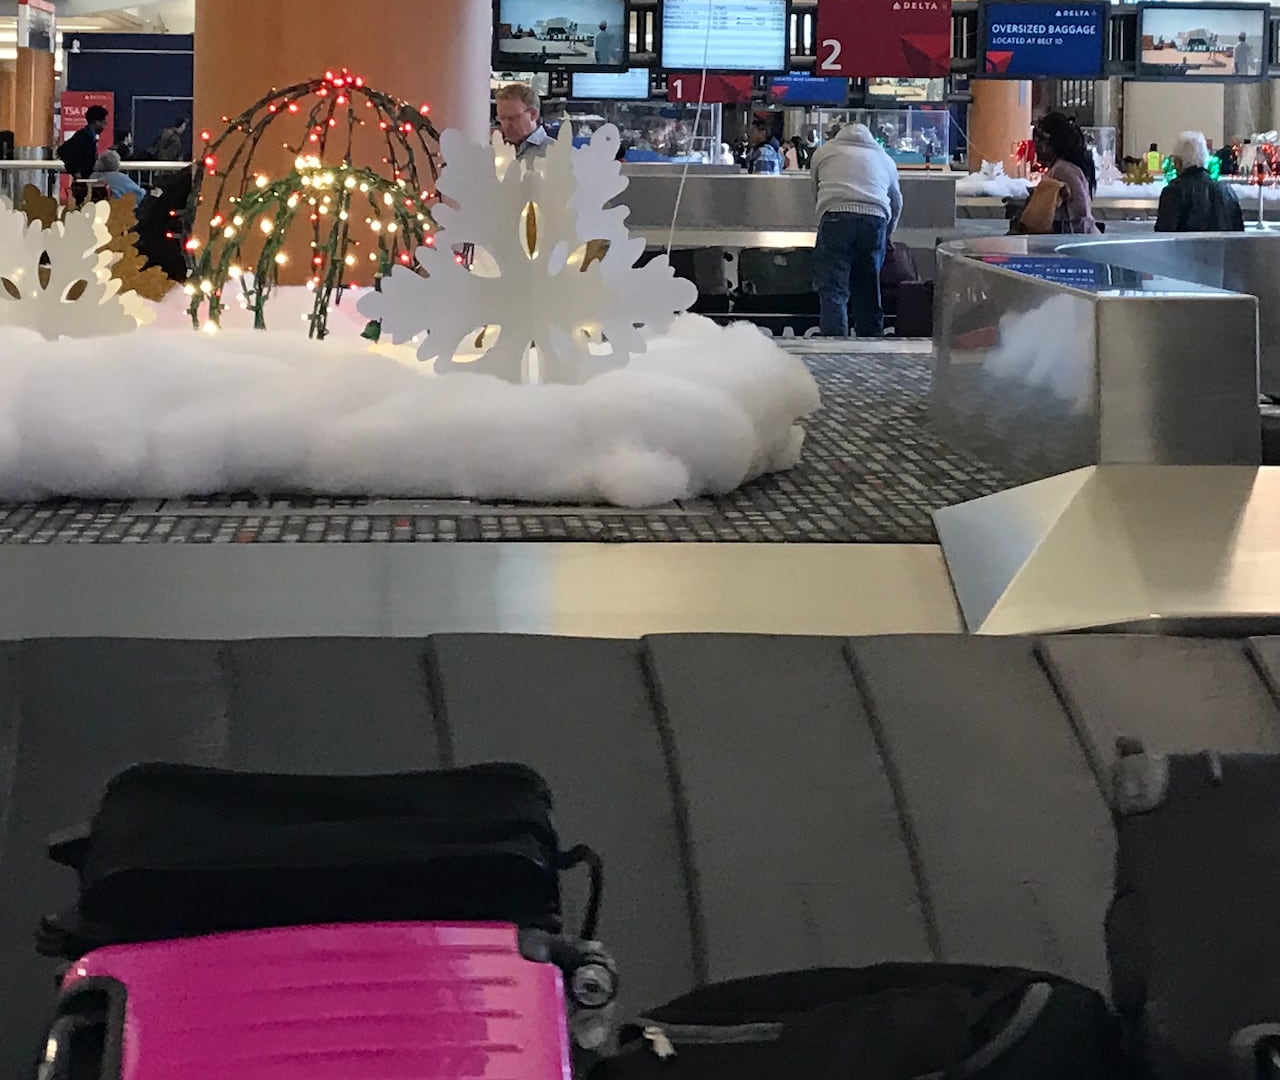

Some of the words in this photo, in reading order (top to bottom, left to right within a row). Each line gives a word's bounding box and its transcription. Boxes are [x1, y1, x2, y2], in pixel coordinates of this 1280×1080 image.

[904, 2, 938, 10] DELTA
[992, 24, 1046, 34] OVERSIZED
[1048, 24, 1096, 35] BAGGAGE
[992, 37, 1025, 45] LOCATED
[821, 39, 842, 70] 2
[672, 79, 683, 99] 1
[64, 106, 80, 115] TSA
